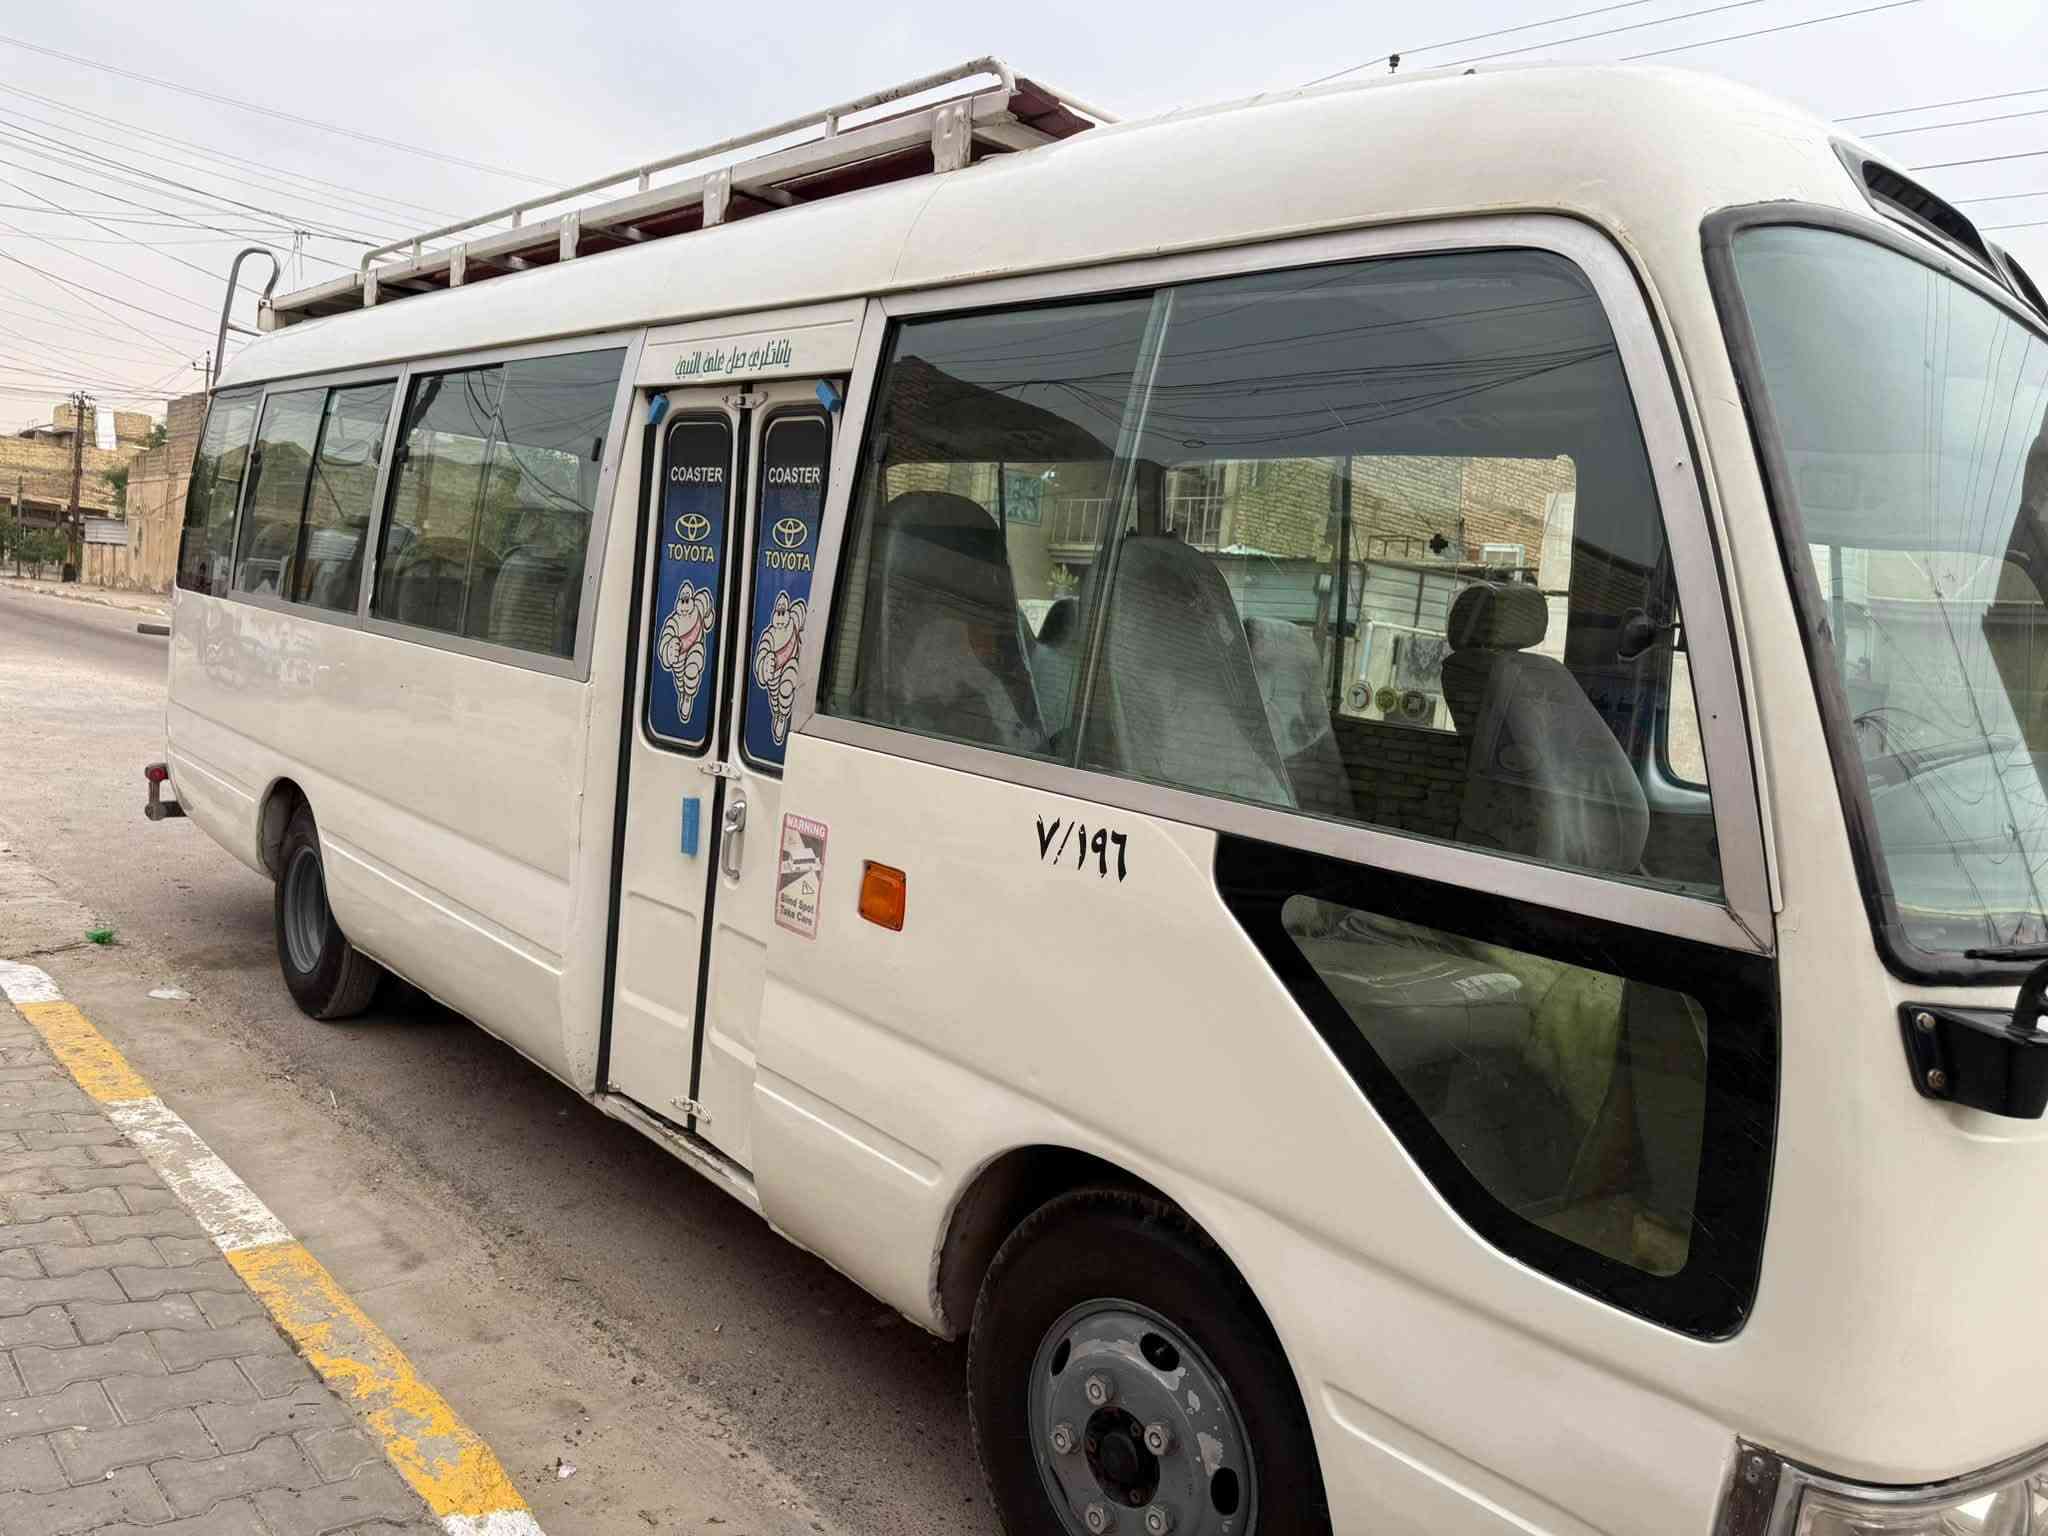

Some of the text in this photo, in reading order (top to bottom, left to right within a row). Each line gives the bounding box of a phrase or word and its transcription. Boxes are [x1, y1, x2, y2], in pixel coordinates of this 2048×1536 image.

[670, 466, 723, 483] COASTER
[768, 466, 821, 484] COASTER
[667, 543, 715, 563] TOYOTA
[765, 551, 811, 571] TOYOTA
[784, 814, 826, 838] WARNING
[780, 904, 813, 926] Take Care
[798, 899, 814, 914] Spot
